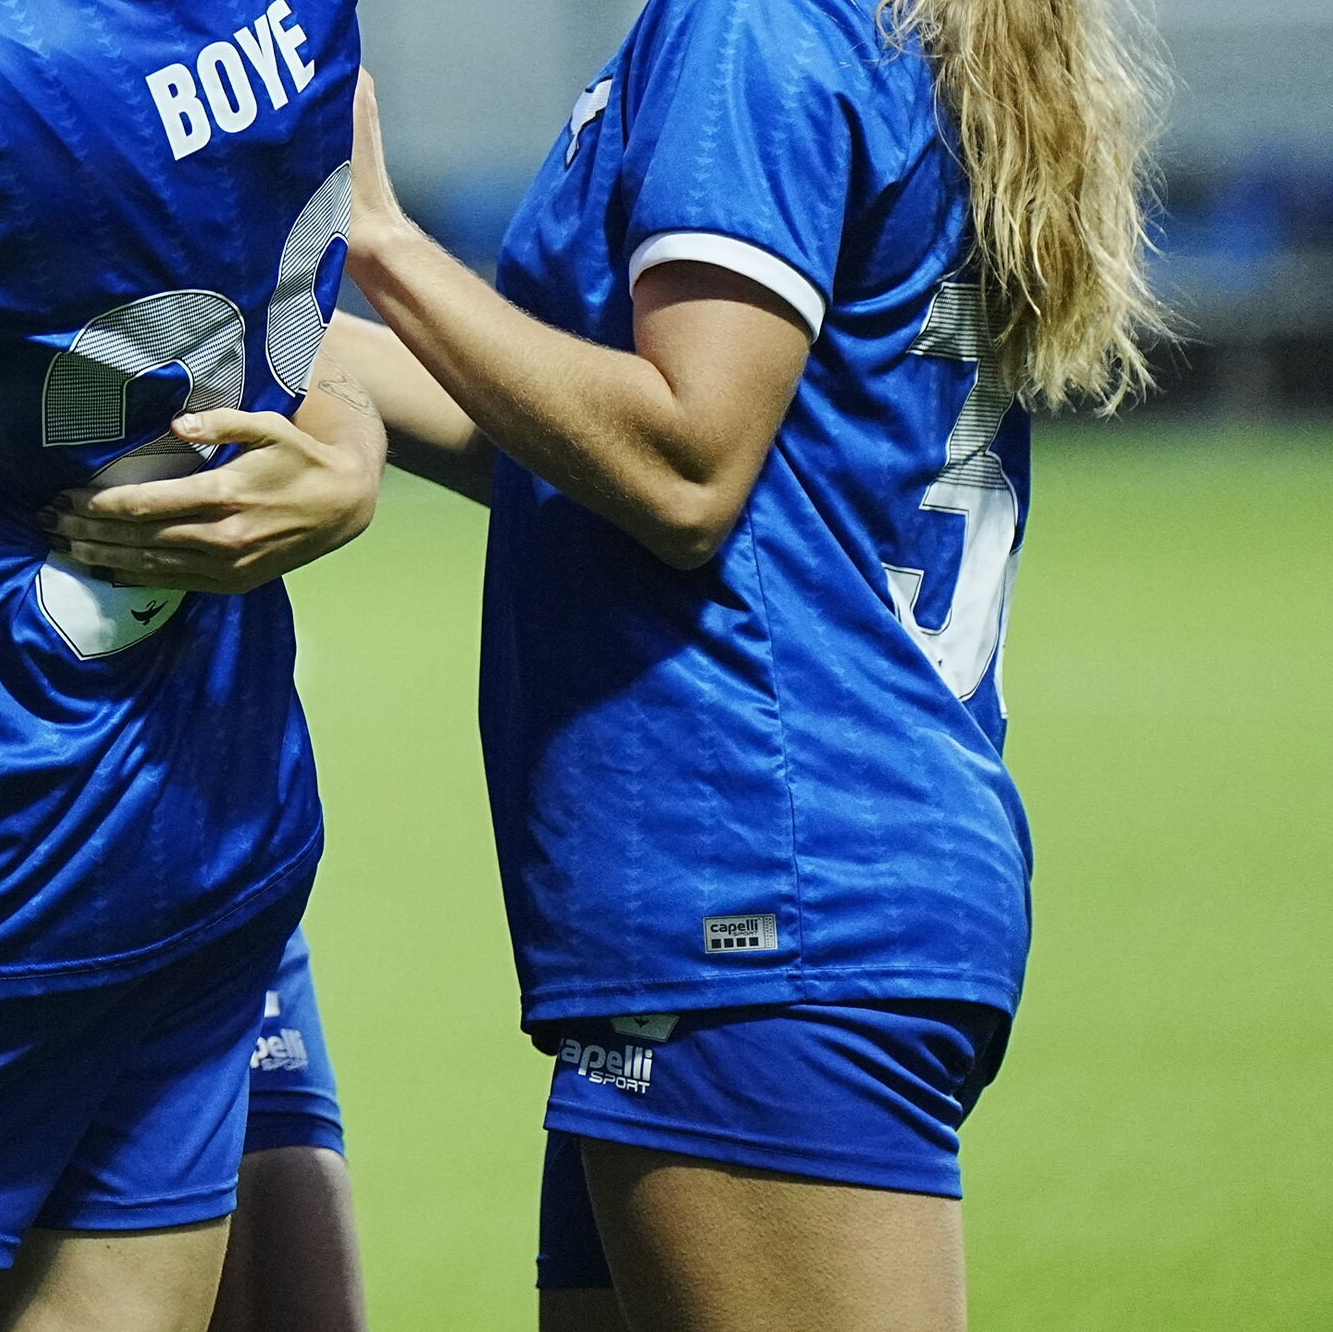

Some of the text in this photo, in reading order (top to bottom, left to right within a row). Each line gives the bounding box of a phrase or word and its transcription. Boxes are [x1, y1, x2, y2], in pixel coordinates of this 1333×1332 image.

[710, 918, 759, 935] capelli
[249, 1027, 308, 1069] pelli
[557, 1037, 653, 1081] apelli
[588, 1070, 651, 1094] SPORT
